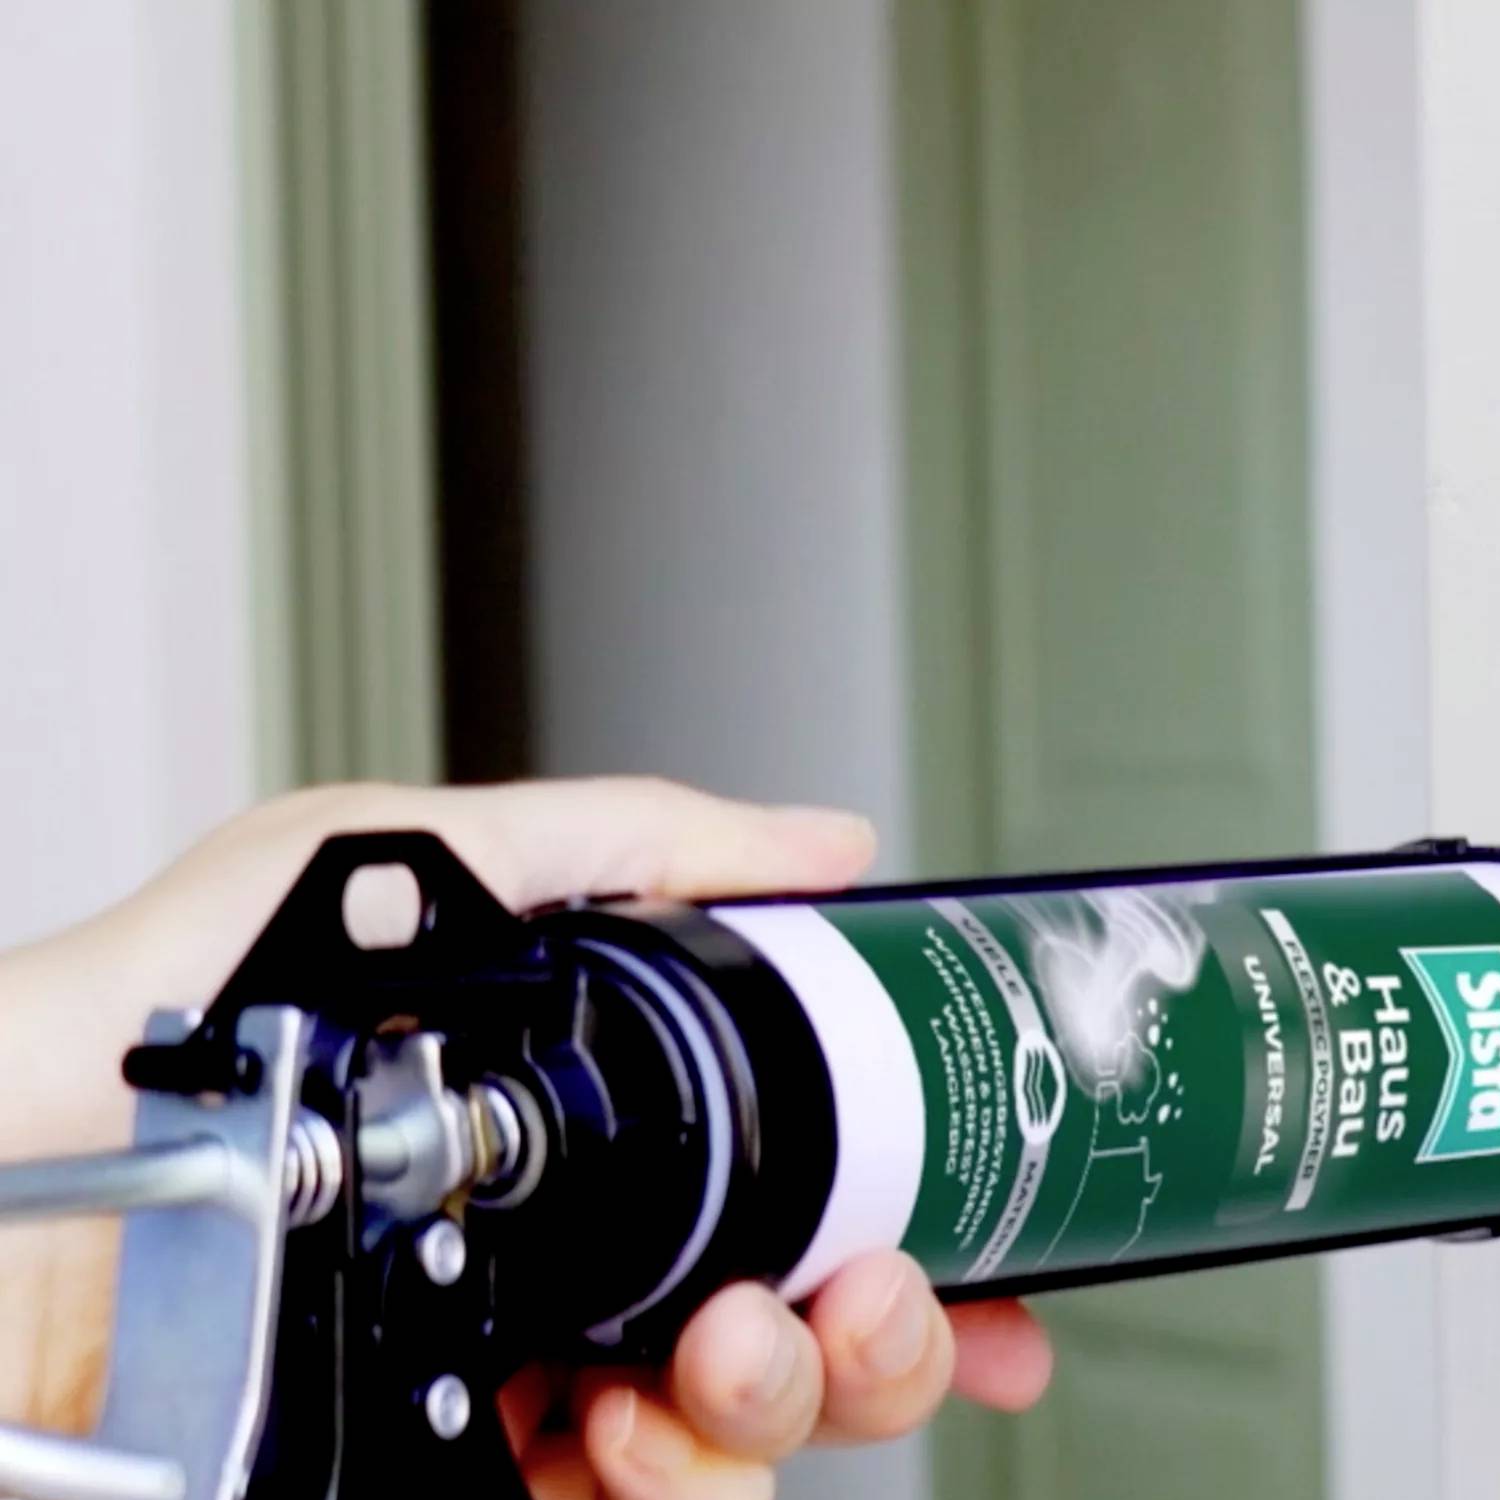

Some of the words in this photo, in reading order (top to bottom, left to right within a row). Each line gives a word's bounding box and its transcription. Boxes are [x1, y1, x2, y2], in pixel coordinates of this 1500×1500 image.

[923, 947, 988, 1073] DRINNEN
[961, 917, 1022, 997] VIELE
[1284, 940, 1327, 1053] FLEXTEC
[1322, 961, 1361, 1007] &
[930, 1018, 961, 1175] LANGLEBIG
[942, 1005, 975, 1186] WASSERFEST
[1243, 955, 1286, 1175] UNIVERSAL
[1302, 1060, 1330, 1181] POLYMER
[1331, 1029, 1373, 1158] Bau
[1366, 975, 1410, 1142] Haus
